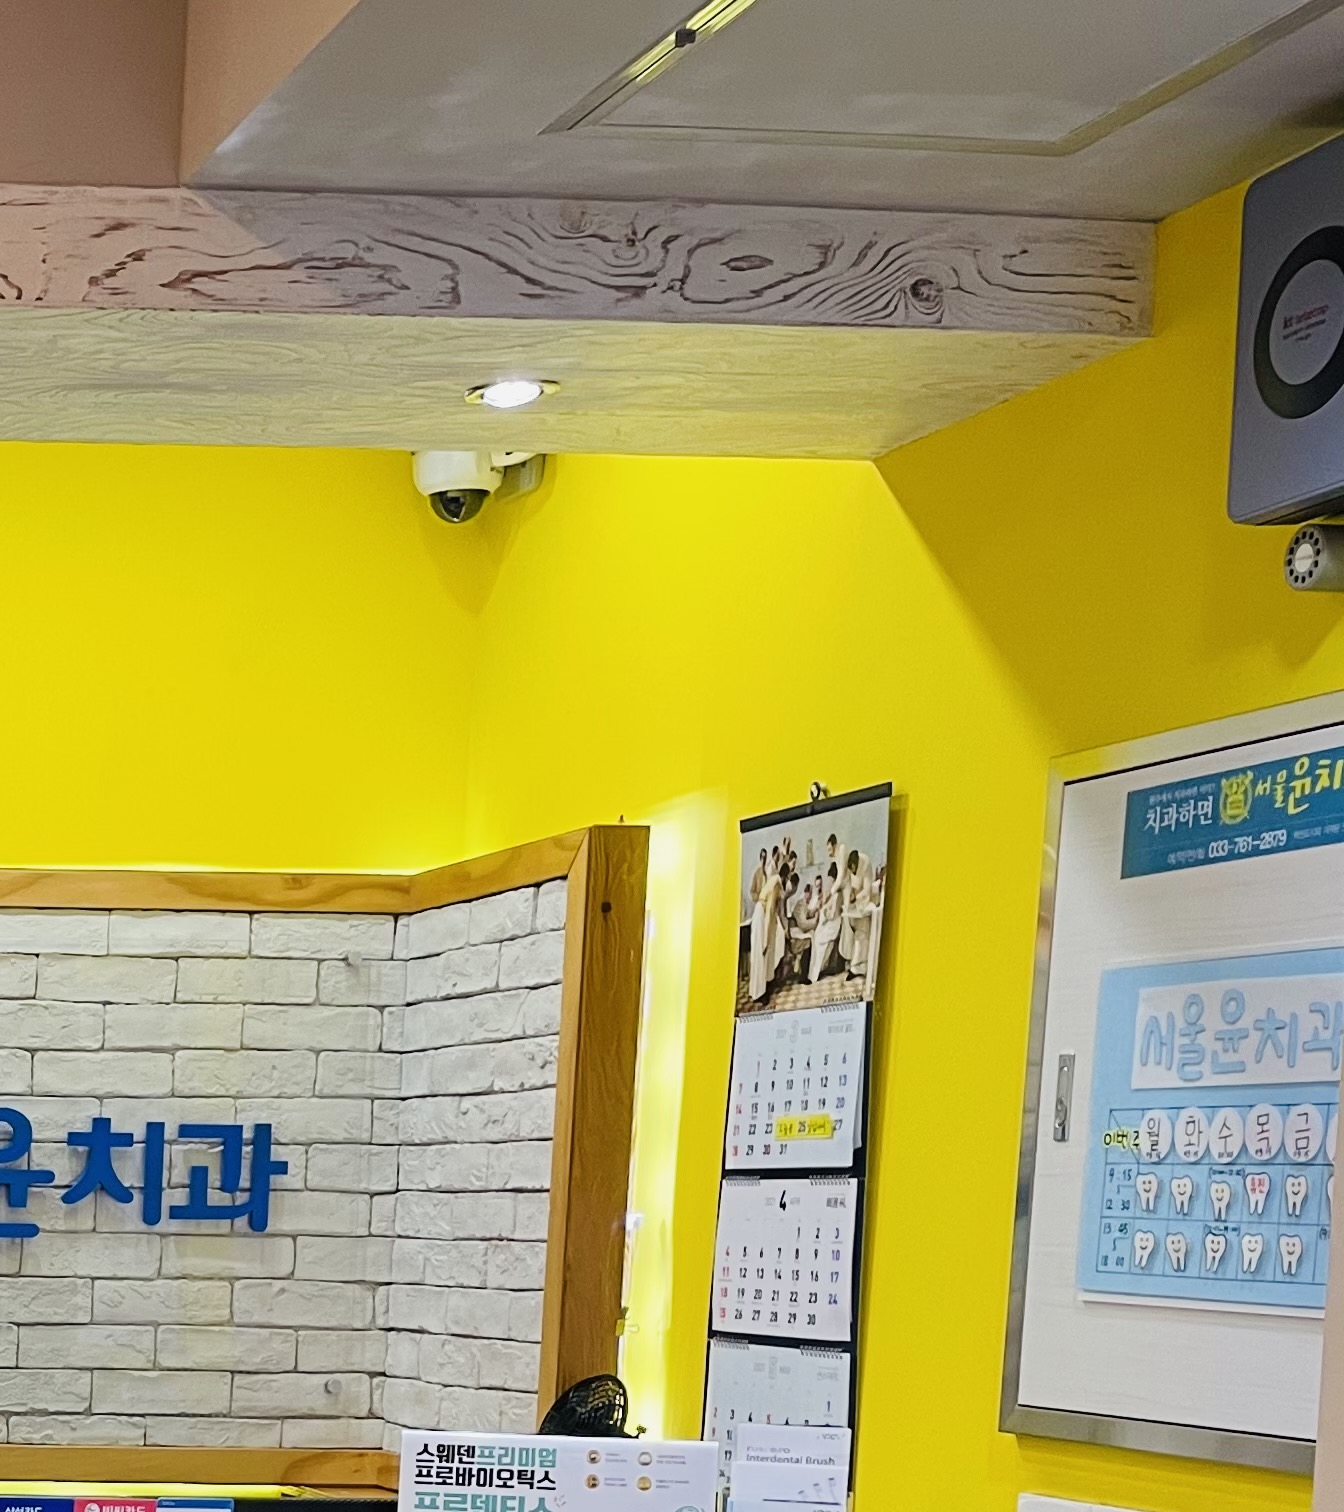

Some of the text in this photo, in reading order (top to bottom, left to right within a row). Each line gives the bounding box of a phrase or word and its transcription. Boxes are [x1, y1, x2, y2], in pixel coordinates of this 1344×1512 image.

[1143, 795, 1213, 835] 치과하면
[1208, 829, 1287, 858] 033-761-2879
[821, 1076, 828, 1087] 12
[1147, 1112, 1311, 1152] 월 화 수 목 금
[779, 1190, 786, 1211] 4
[740, 1268, 818, 1282] 12 16
[790, 1291, 817, 1303] 22 23
[735, 1309, 816, 1325] 26 29 30
[746, 1455, 835, 1465] Interdental Brush
[414, 1465, 557, 1490] 프로바이오틱스
